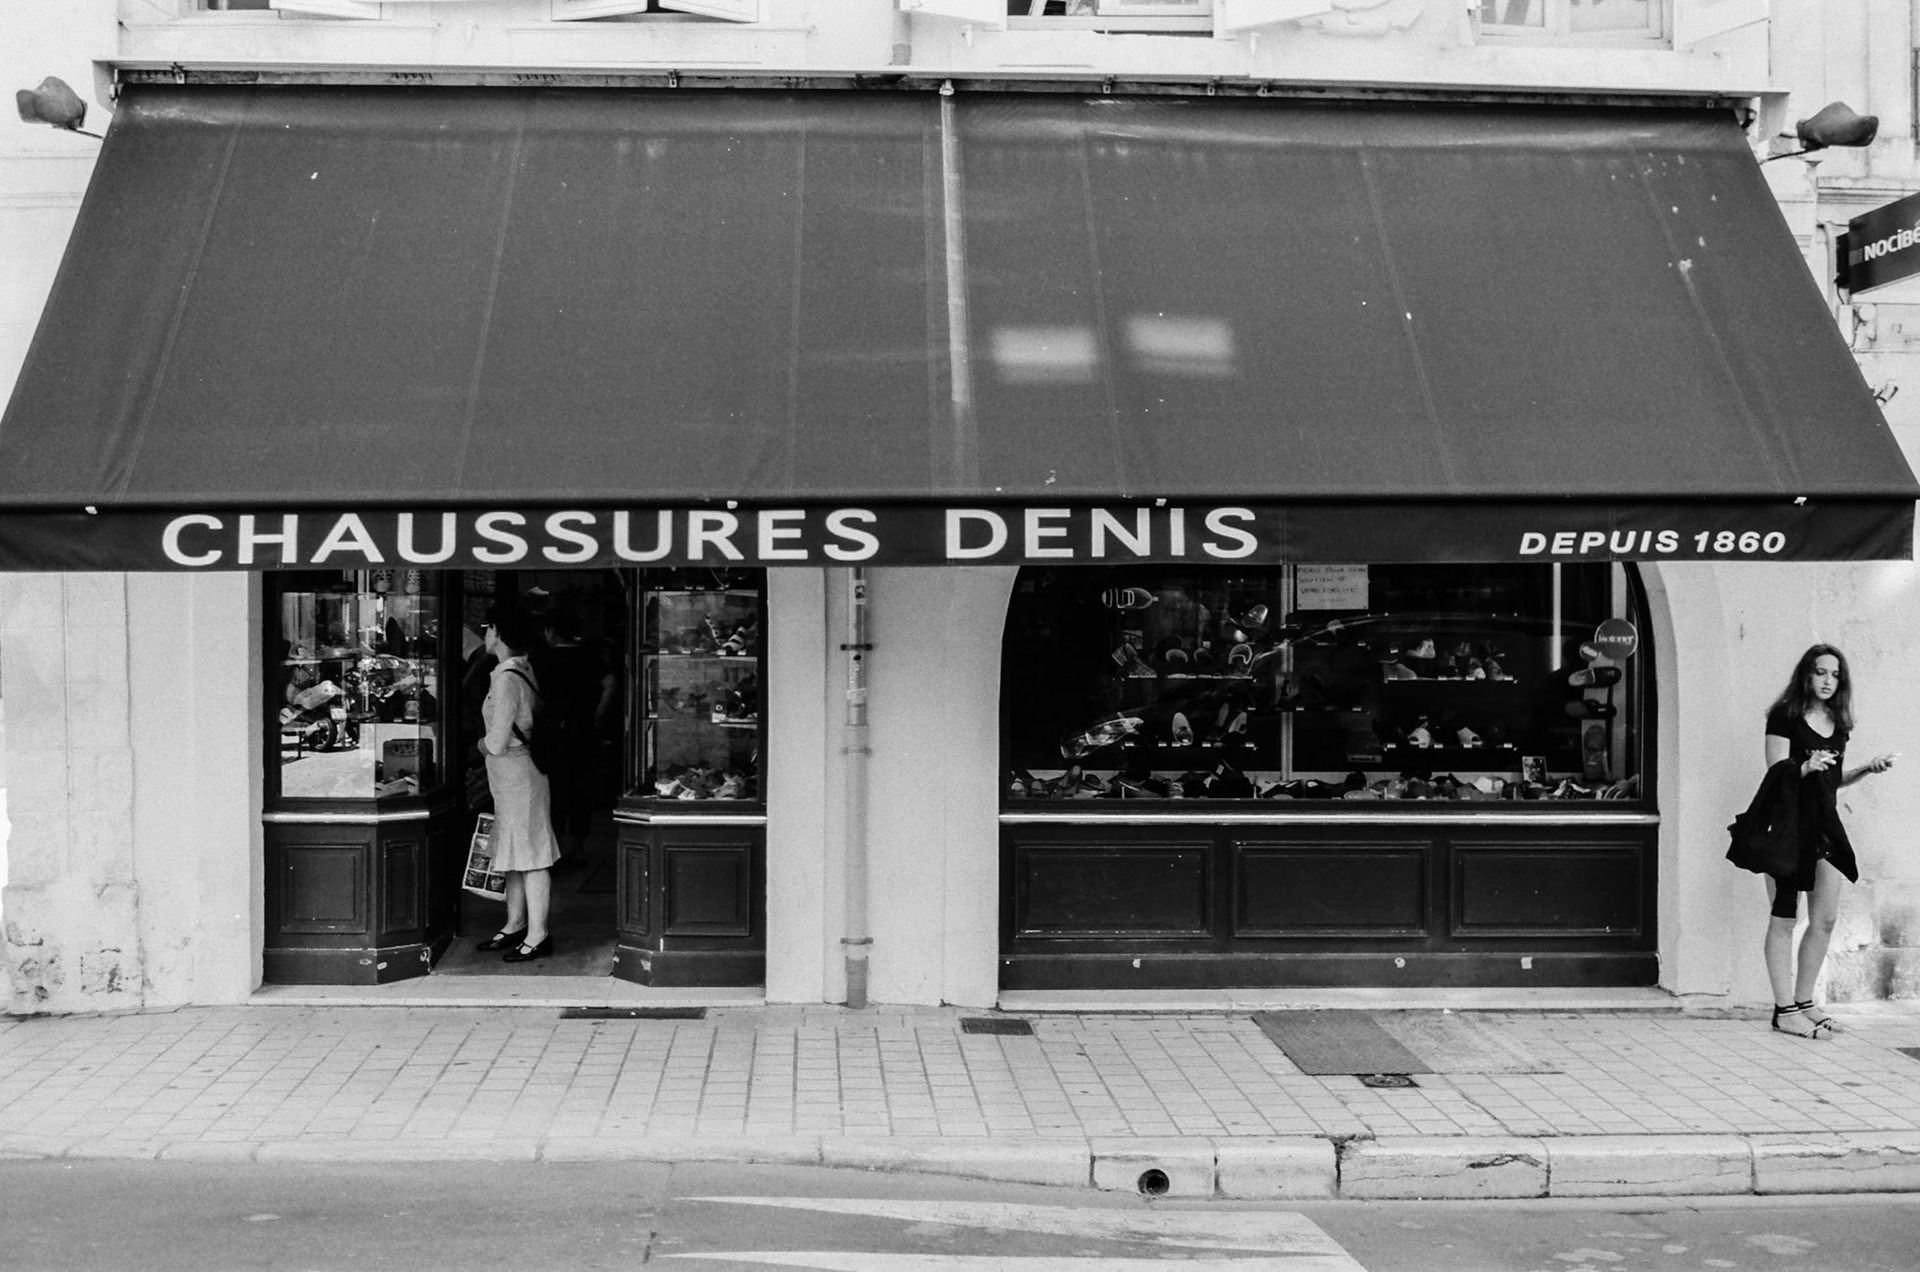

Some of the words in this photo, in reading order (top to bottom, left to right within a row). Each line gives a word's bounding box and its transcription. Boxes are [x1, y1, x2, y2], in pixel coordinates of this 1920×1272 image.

[162, 510, 879, 566] CHAUSSURES
[946, 508, 1257, 558] DENIS
[1520, 530, 1679, 554] DEPUIS
[1695, 531, 1785, 553] 1860
